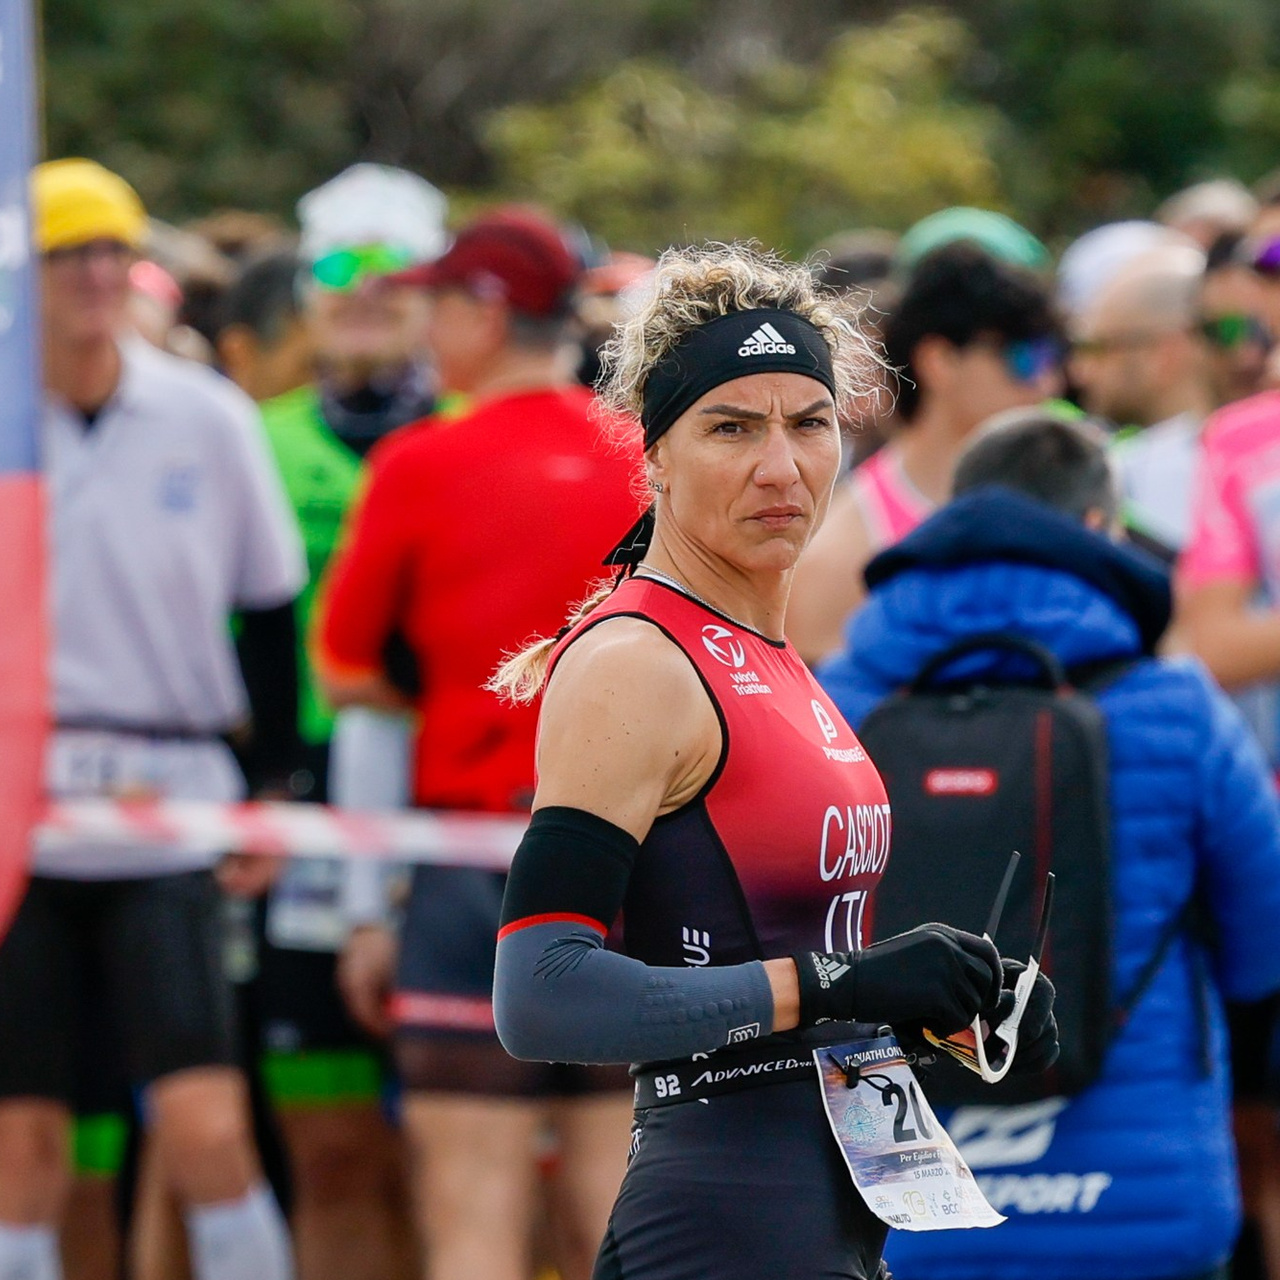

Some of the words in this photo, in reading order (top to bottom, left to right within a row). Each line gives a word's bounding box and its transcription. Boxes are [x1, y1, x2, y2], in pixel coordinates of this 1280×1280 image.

[738, 341, 796, 357] adidas
[730, 671, 760, 684] World
[732, 683, 772, 696] Triathlon
[654, 1074, 681, 1099] 92
[899, 1153, 912, 1164] Per
[913, 1170, 921, 1180] 15
[922, 1168, 944, 1179] MARZO
